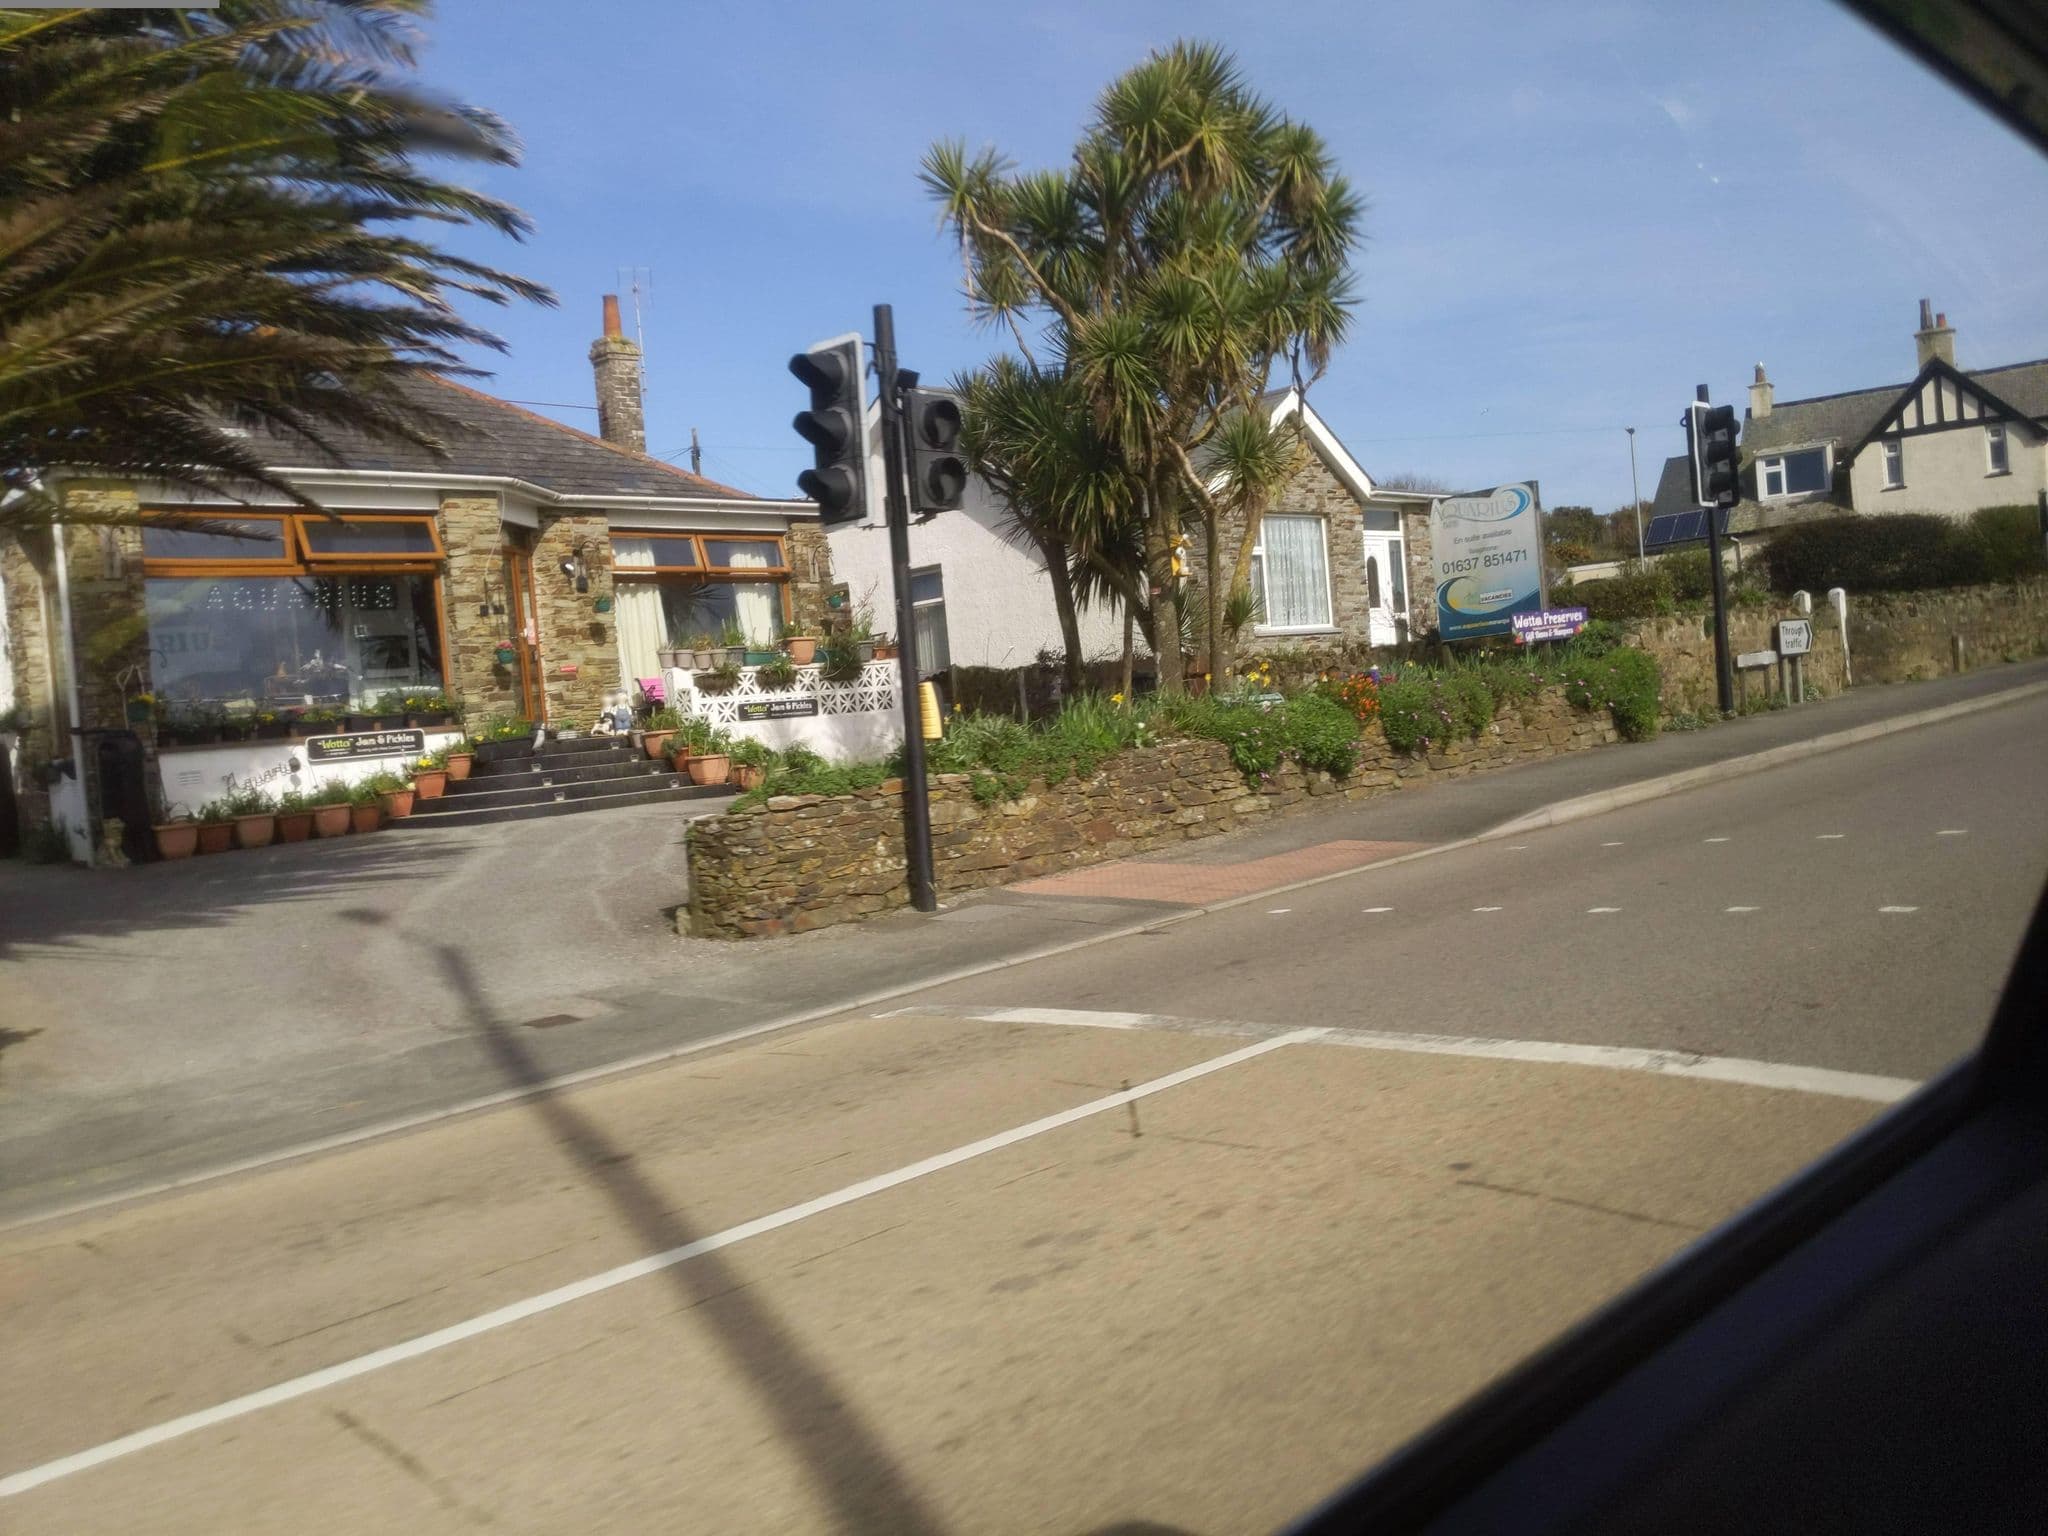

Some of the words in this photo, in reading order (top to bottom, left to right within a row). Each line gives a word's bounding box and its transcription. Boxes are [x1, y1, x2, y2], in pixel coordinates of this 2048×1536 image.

[1442, 557, 1479, 575] 01637
[1483, 549, 1527, 568] 851471
[206, 585, 391, 611] AQUARIUS
[1513, 614, 1542, 629] Wotta
[1543, 611, 1583, 626] Preserves
[1782, 625, 1804, 637] Through
[1785, 638, 1802, 649] traffic
[377, 734, 385, 744] &
[386, 733, 415, 744] Pickles
